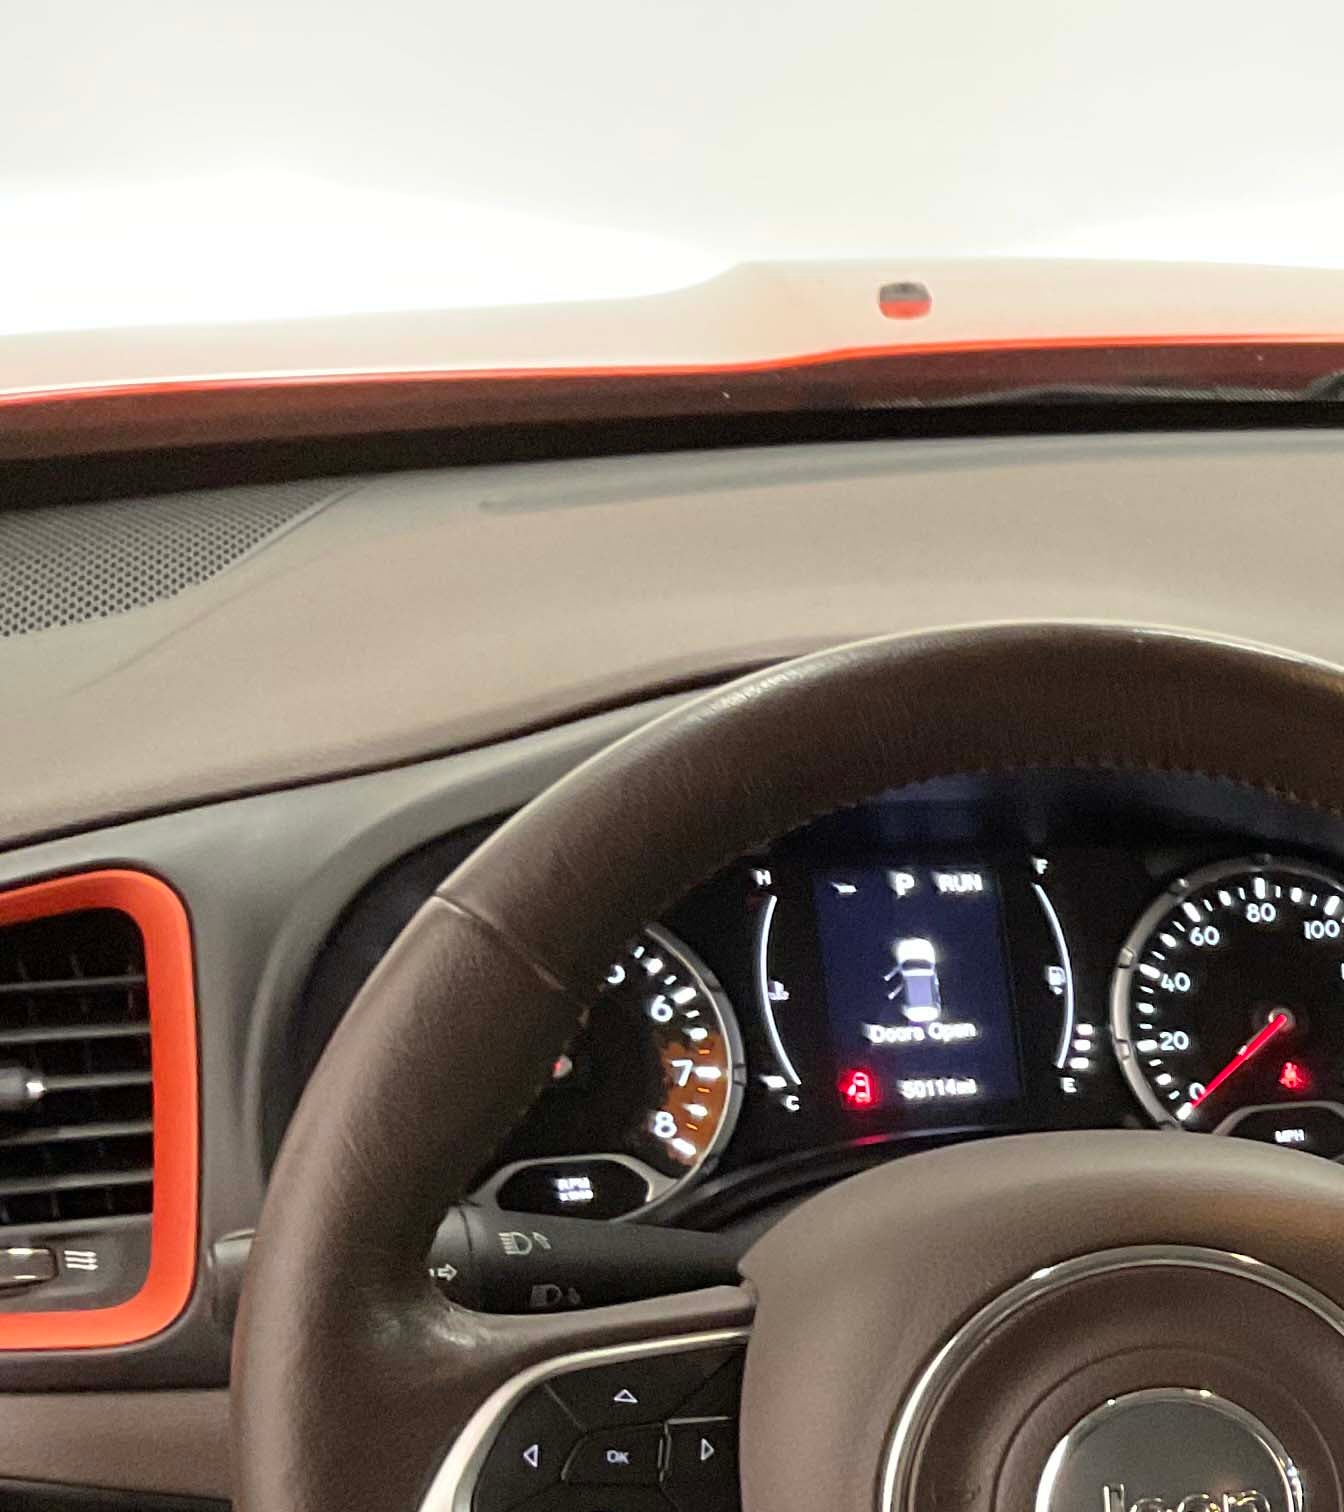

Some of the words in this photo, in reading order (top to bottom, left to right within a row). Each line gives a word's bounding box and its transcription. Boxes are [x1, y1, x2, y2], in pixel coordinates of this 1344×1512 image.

[755, 869, 772, 886] H
[893, 872, 915, 896] P
[935, 872, 983, 894] RUN
[1246, 904, 1276, 923] 80
[1190, 926, 1220, 946] 60
[1303, 919, 1340, 939] 100
[1160, 973, 1191, 993] 40
[651, 995, 673, 1022] 6
[1159, 1031, 1189, 1052] 20
[672, 1059, 693, 1087] 7
[1061, 1078, 1077, 1093] E
[1189, 1082, 1206, 1101] 0
[653, 1111, 677, 1138] 8
[606, 1449, 629, 1465] OK
